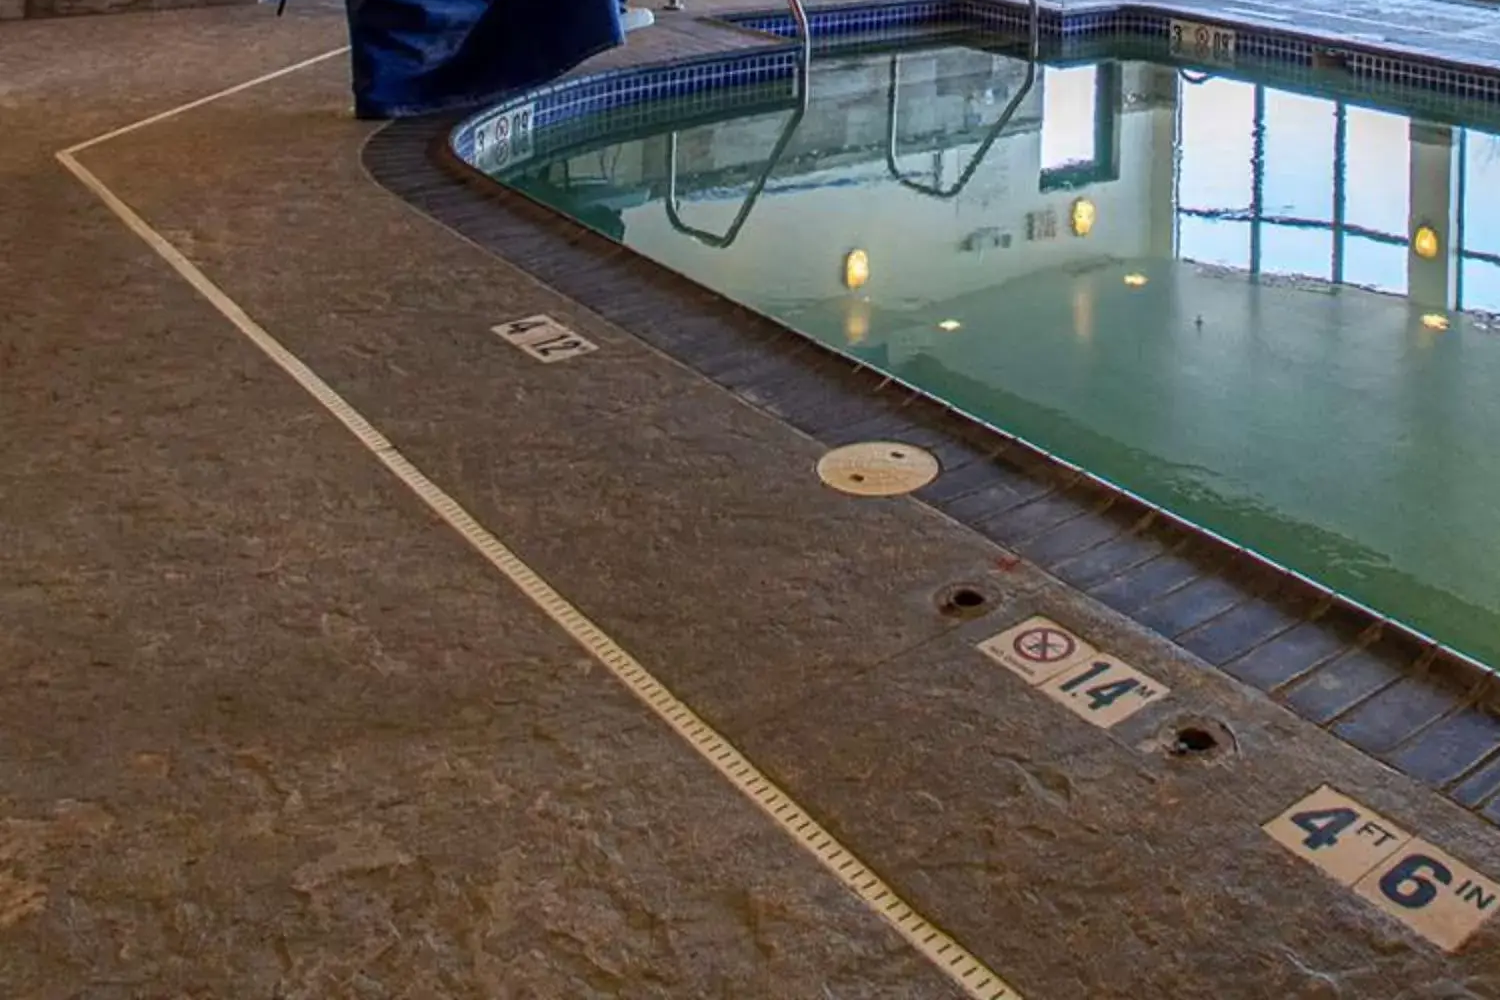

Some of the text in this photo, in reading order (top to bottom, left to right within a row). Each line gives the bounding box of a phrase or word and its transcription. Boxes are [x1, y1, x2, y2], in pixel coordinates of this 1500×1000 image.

[1290, 807, 1496, 911] 4 FT 6 IN
